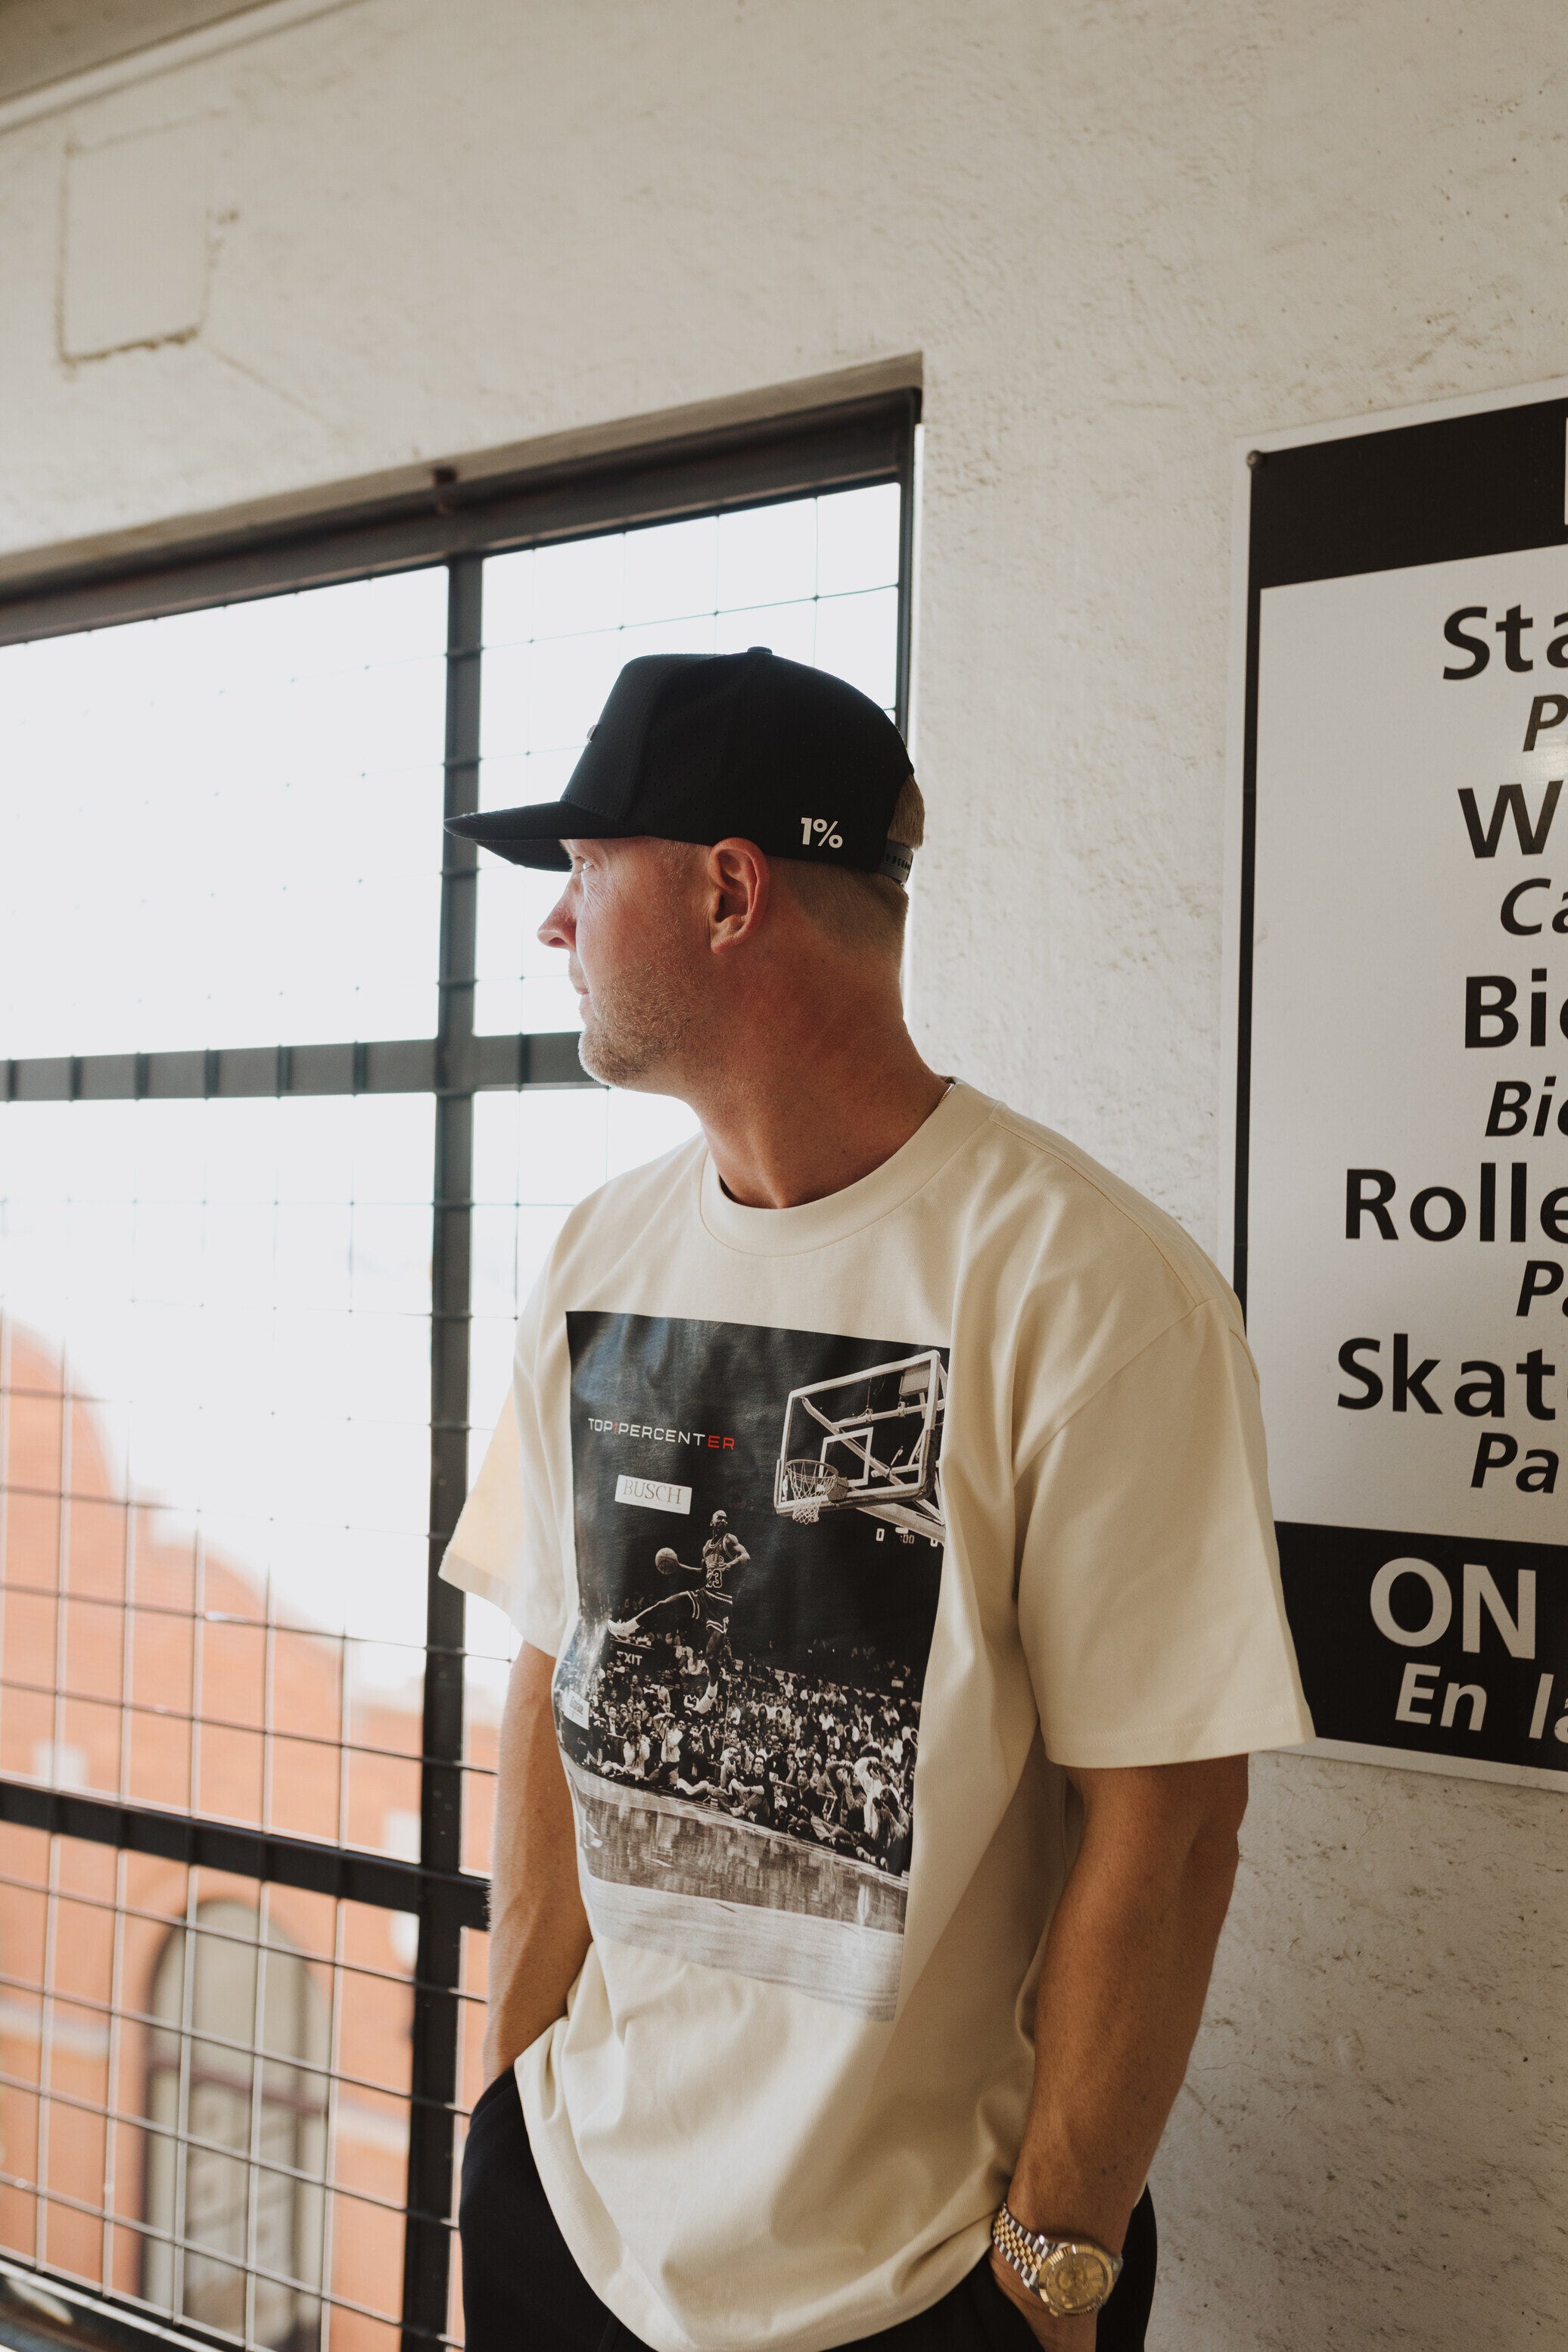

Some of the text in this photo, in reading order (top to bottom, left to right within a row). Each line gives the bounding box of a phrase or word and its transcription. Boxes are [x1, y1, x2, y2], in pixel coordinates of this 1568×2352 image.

[801, 817, 843, 848] 1%
[1465, 968, 1568, 1049] Bi
[1485, 1075, 1568, 1137] Bi
[1516, 1260, 1568, 1317] P
[1336, 1333, 1568, 1420] Skat
[624, 1479, 682, 1504] BUSCH
[1470, 1432, 1560, 1494] Pa
[1370, 1557, 1536, 1660] ON
[1395, 1663, 1488, 1731] En
